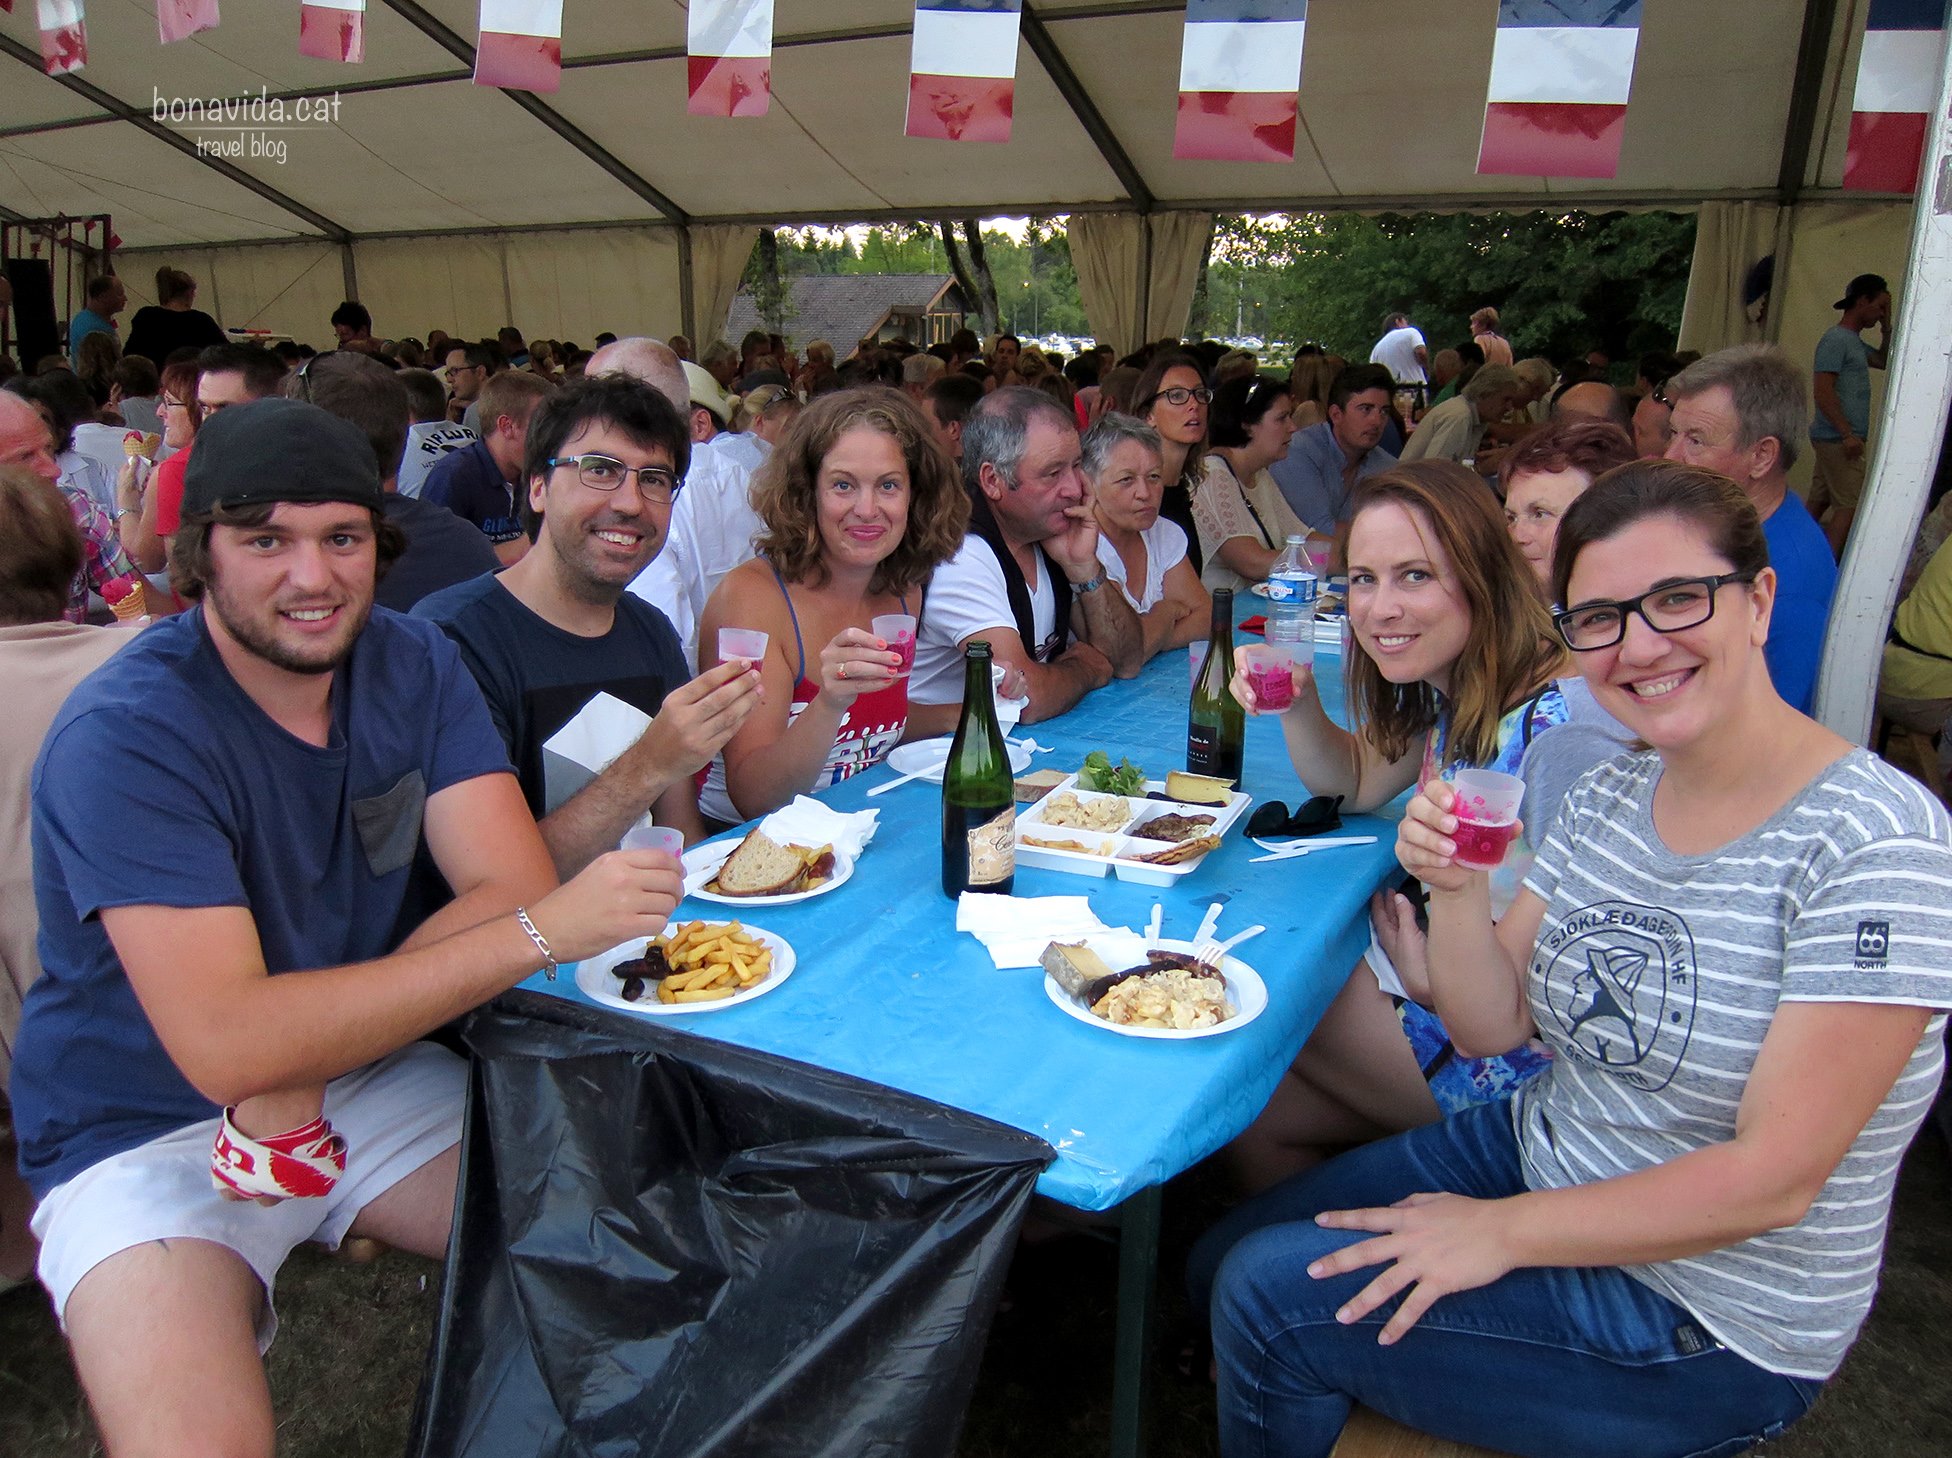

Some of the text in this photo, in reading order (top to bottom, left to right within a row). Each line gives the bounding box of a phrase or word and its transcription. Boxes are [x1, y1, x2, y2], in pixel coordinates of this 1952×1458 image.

[421, 433, 443, 455] RIP
[1671, 958, 1687, 986] HF
[1854, 960, 1888, 970] NORTH
